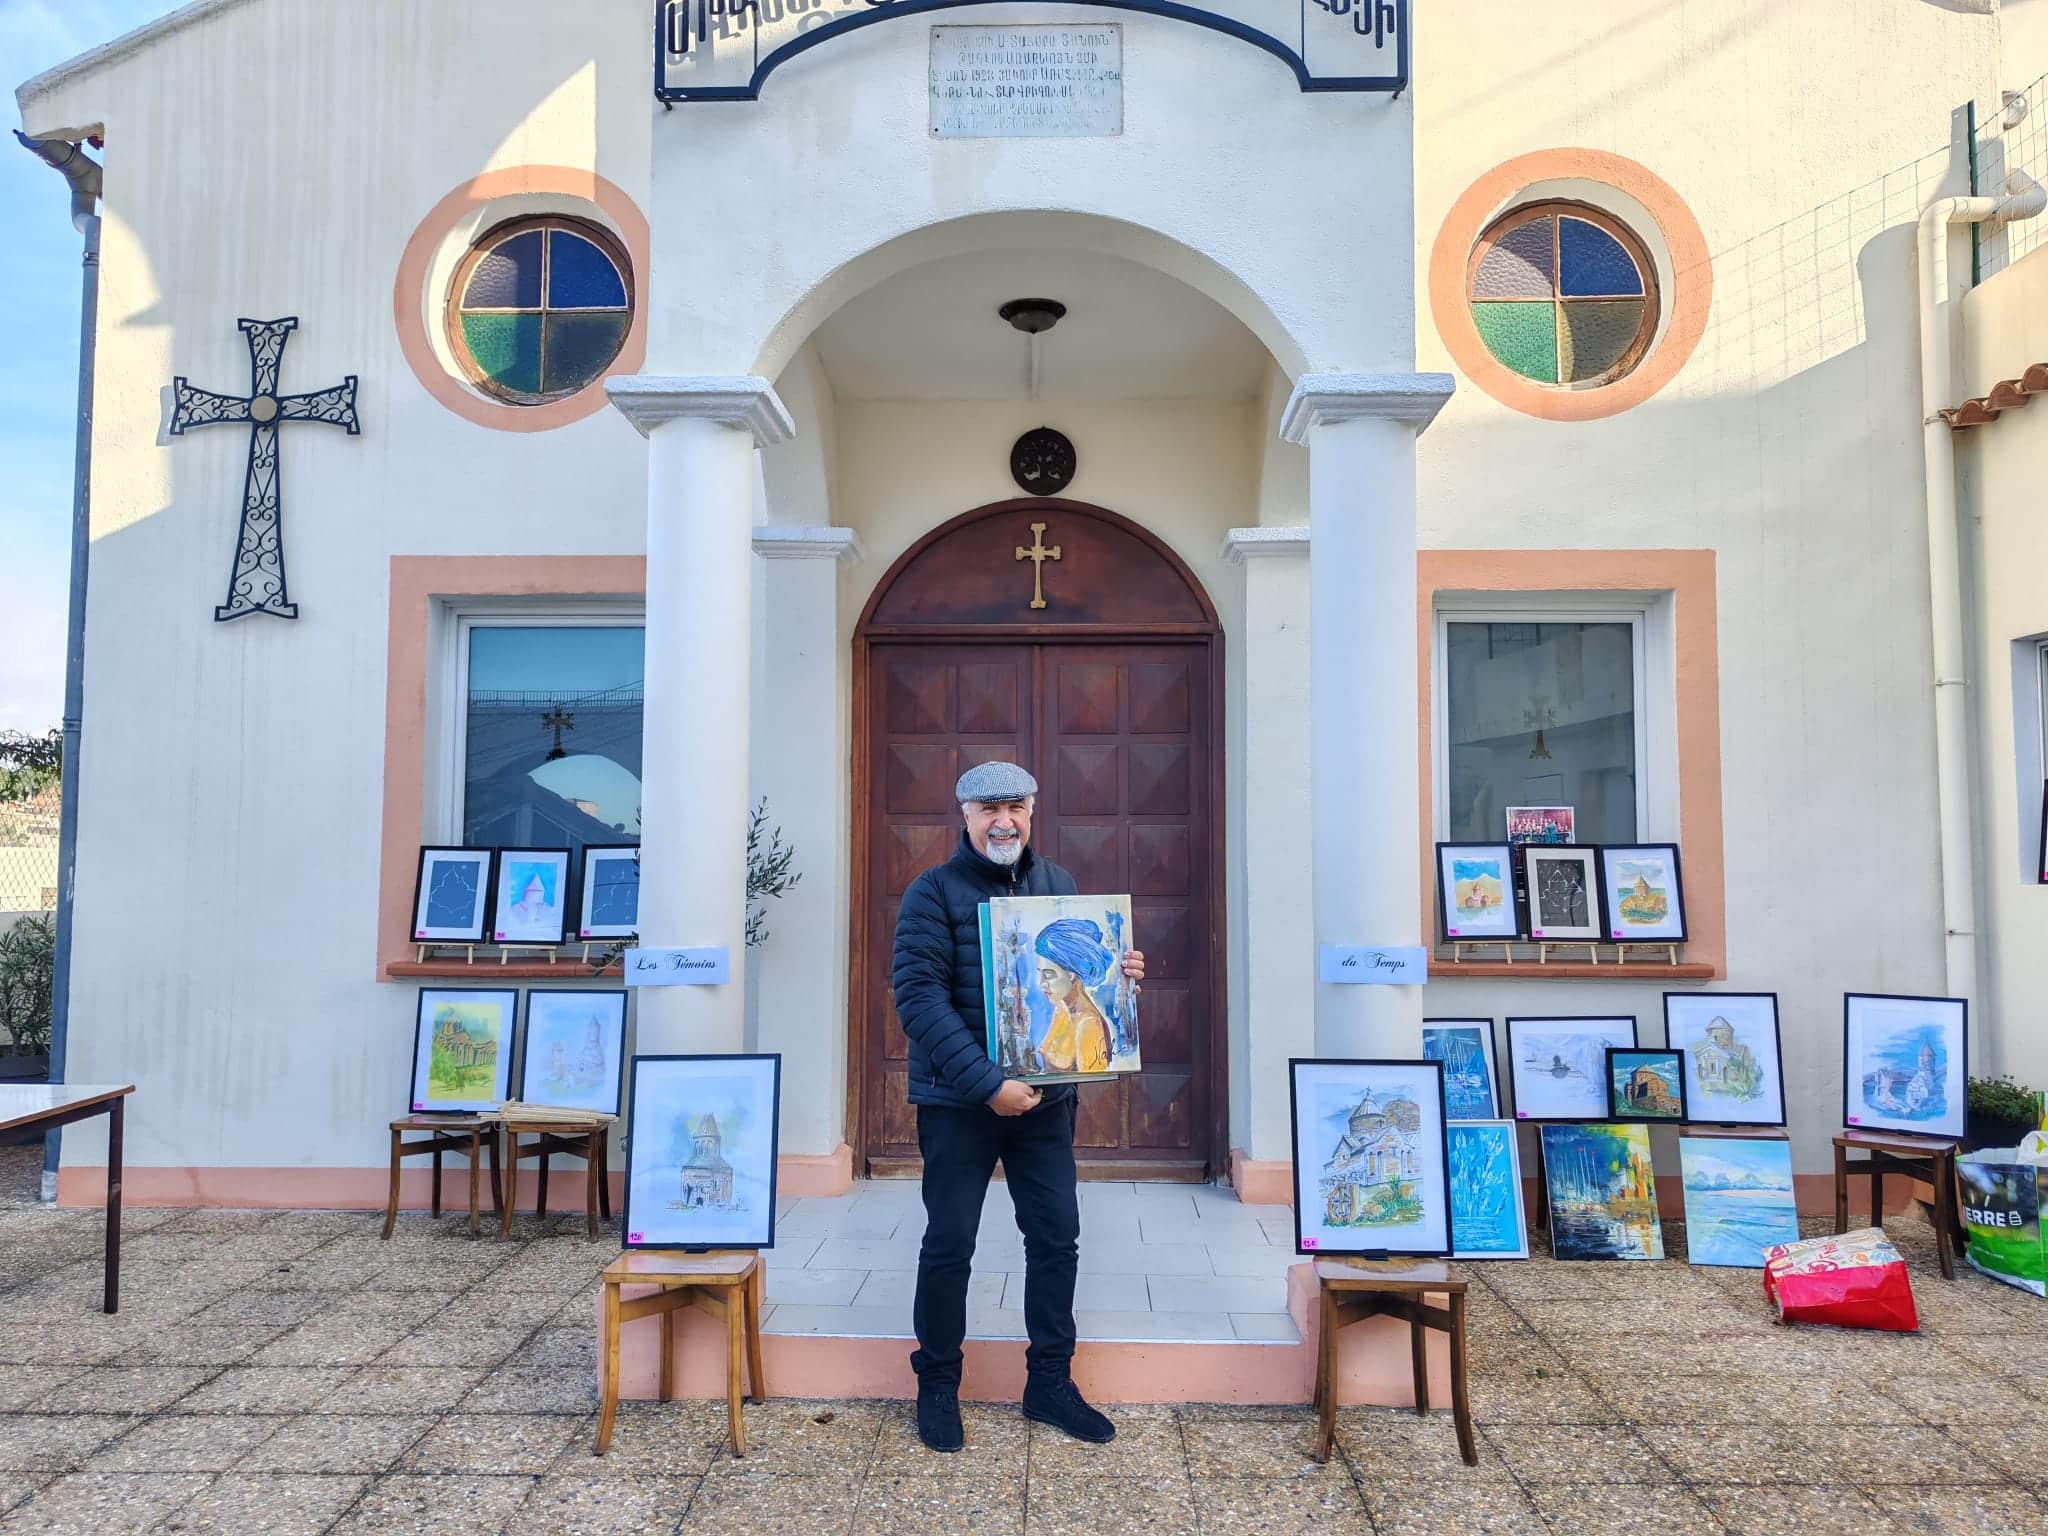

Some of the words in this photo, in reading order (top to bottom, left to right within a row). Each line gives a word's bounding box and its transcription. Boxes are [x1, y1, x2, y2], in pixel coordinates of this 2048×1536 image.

[635, 956, 657, 970] Les
[664, 952, 718, 971] Témoins
[1341, 955, 1357, 967] du
[1364, 951, 1406, 974] Temps
[1964, 1206, 2006, 1227] ERRE
